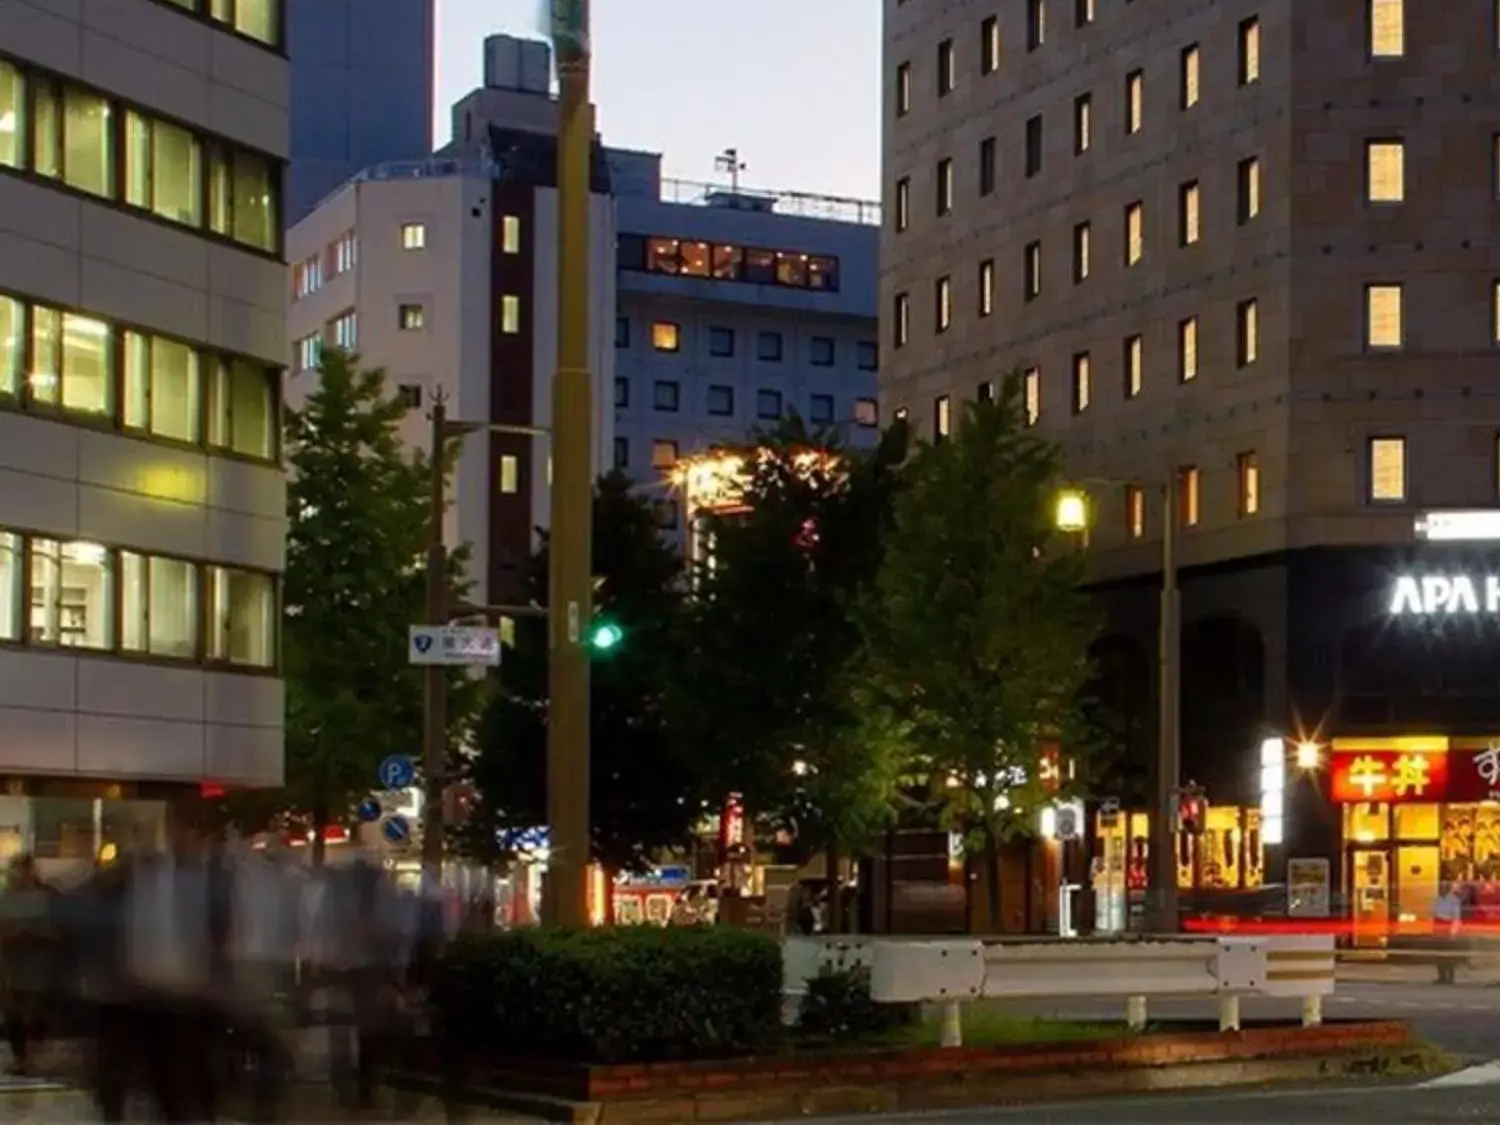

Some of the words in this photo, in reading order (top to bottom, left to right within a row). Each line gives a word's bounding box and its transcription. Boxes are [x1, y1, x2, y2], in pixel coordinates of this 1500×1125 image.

[1388, 575, 1479, 615] APA
[387, 761, 402, 784] P
[1347, 754, 1432, 797] 牛丼
